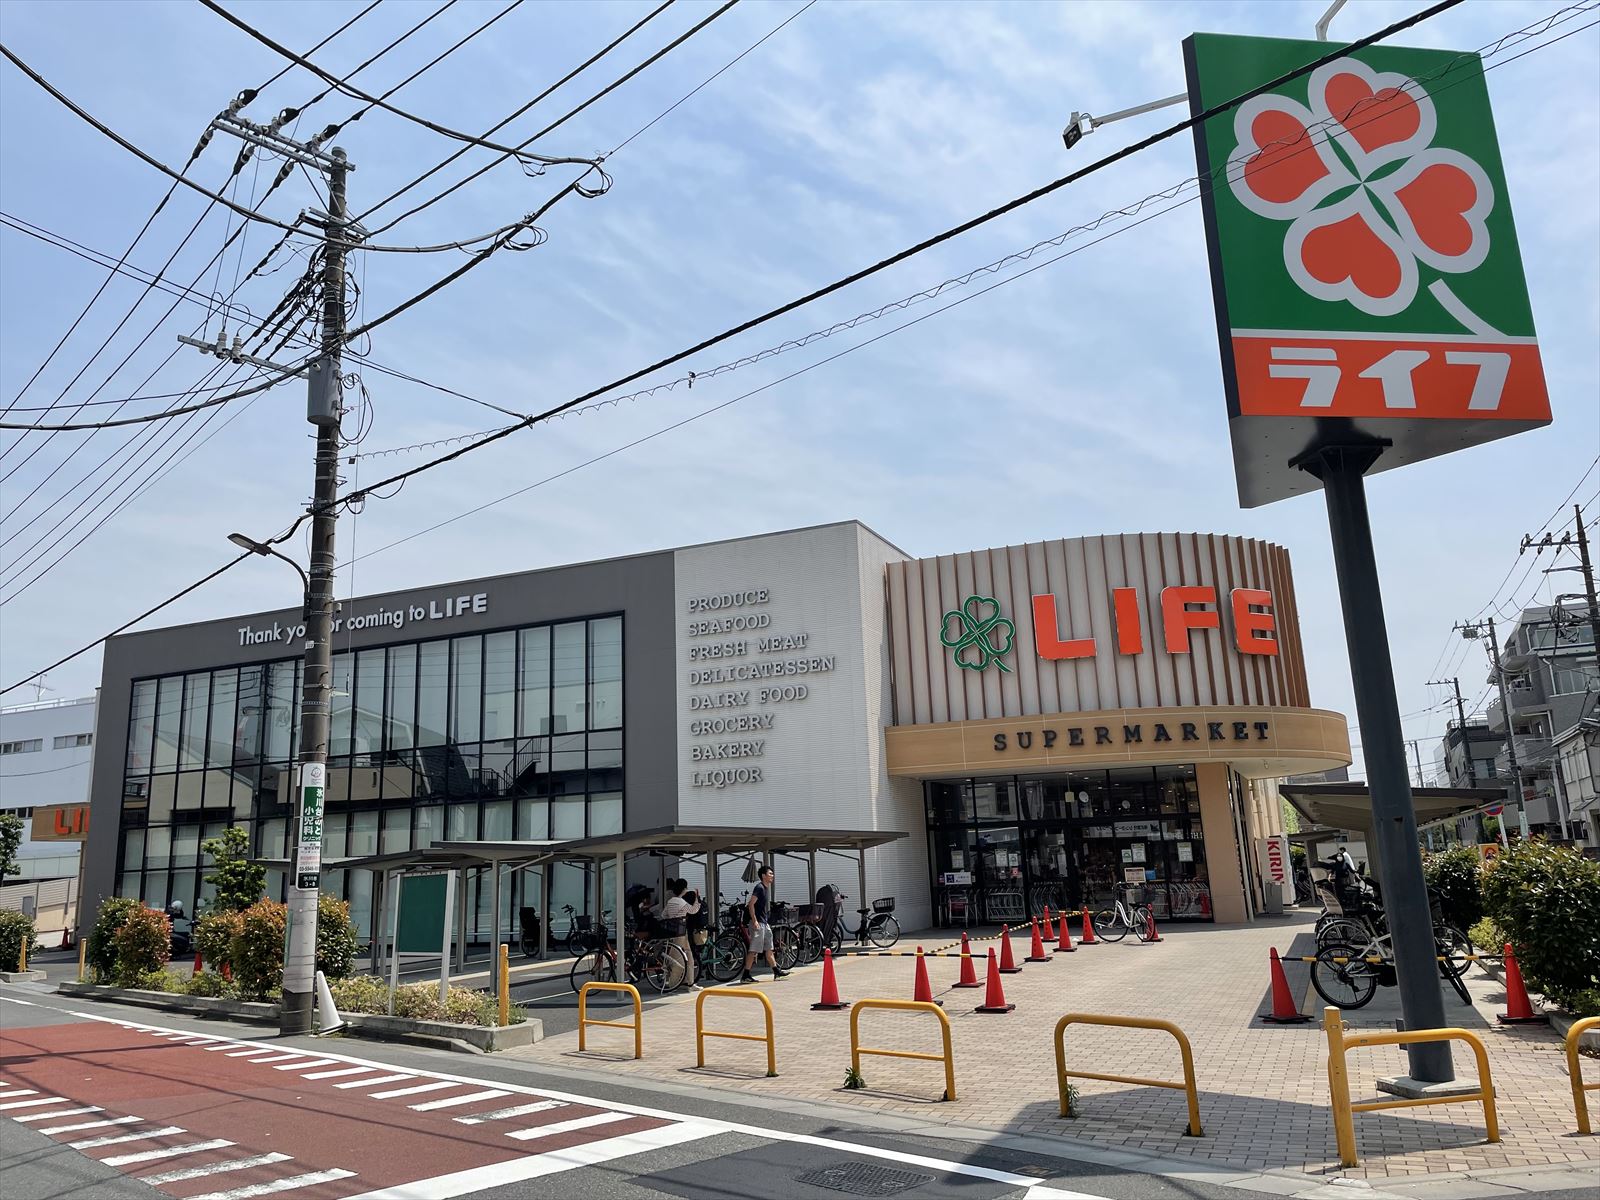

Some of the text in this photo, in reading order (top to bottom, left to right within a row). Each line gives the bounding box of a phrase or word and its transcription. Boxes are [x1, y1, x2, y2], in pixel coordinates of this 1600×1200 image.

[1268, 346, 1511, 410] ライフ
[688, 588, 769, 612] PRODUCE
[238, 622, 282, 646] Thank
[286, 624, 306, 645] yo
[347, 608, 404, 629] coming
[409, 605, 425, 621] to
[429, 593, 487, 619] LIFE
[688, 613, 770, 637] SEAFOOD
[1032, 586, 1279, 660] LIFE
[689, 633, 808, 661] FRESH MEAT
[689, 656, 835, 686] DELICATESSEN
[690, 685, 808, 710] DAIRY FOOD
[690, 713, 774, 736] GROCERY
[994, 721, 1269, 751] SUPERMARKET
[691, 740, 765, 761] BAKERY
[691, 767, 763, 789] LIQUOR
